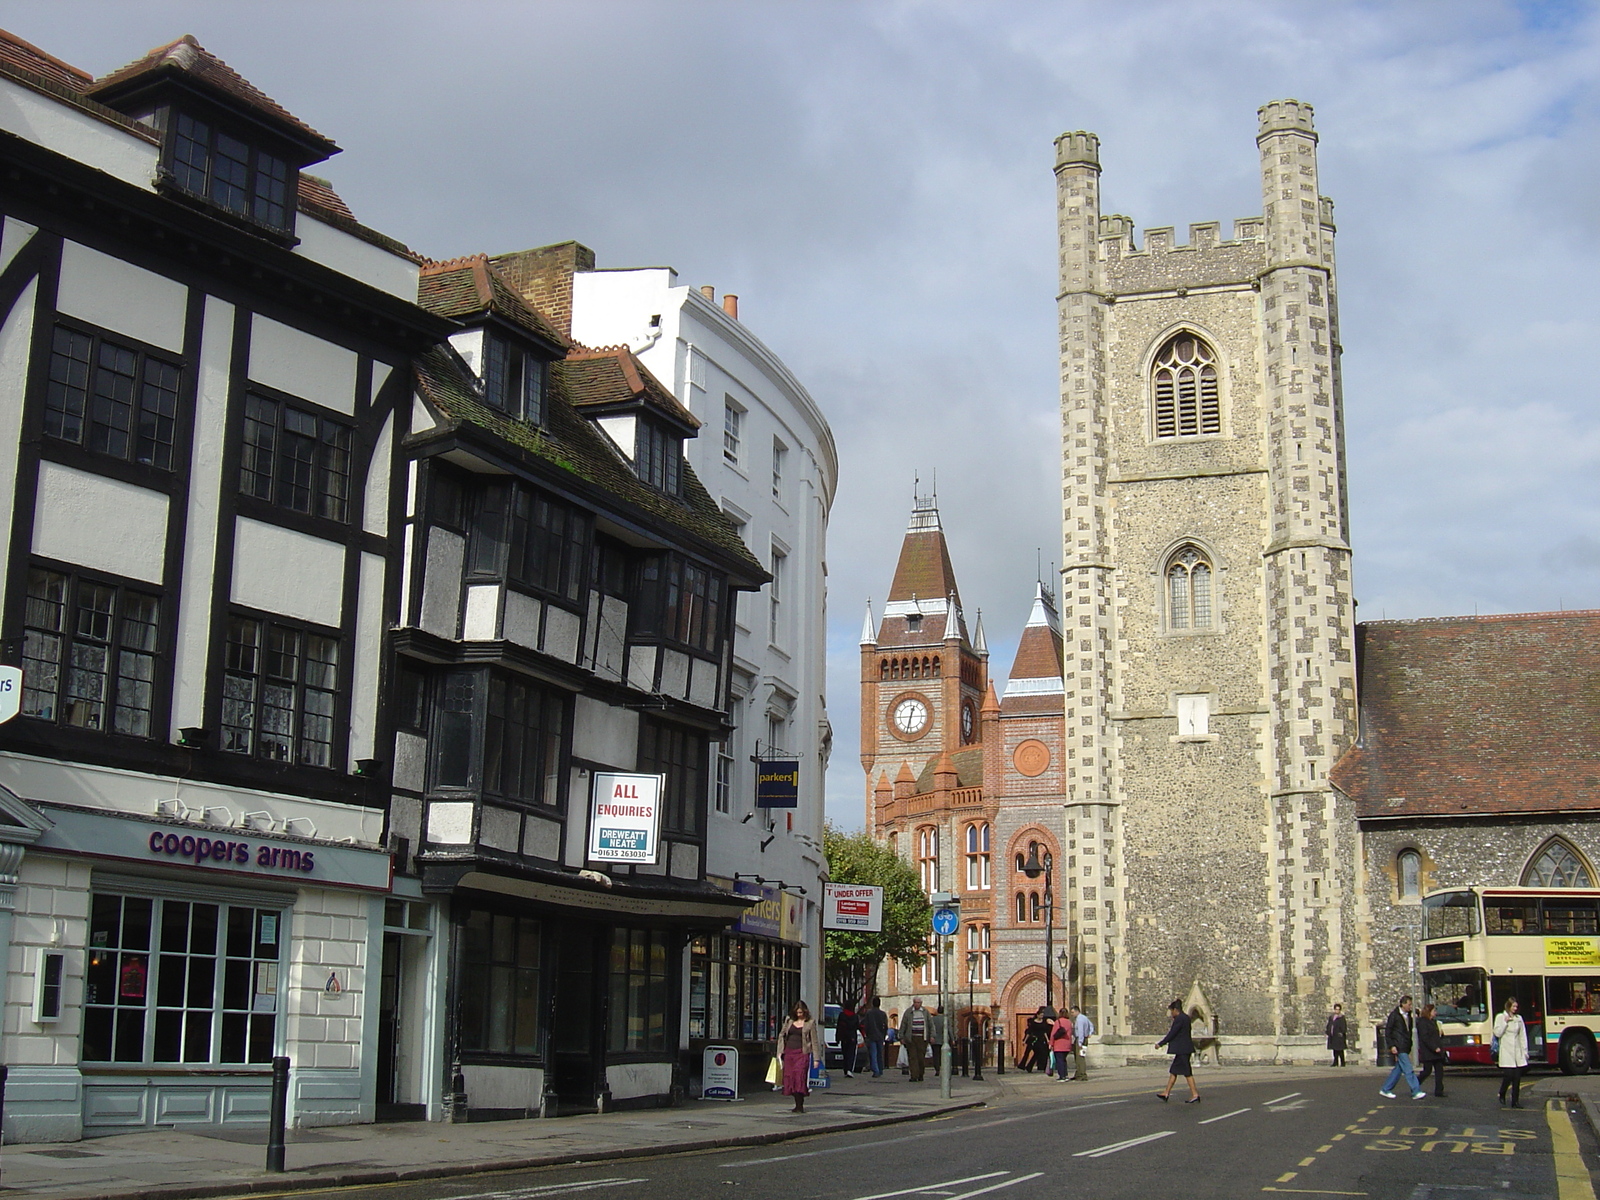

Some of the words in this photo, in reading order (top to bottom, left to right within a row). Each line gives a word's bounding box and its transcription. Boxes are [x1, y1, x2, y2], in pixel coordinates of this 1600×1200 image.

[759, 772, 793, 784] parkers
[613, 784, 639, 799] ALL
[597, 804, 653, 818] ENQUIRIES
[601, 829, 646, 841] DREWEATT
[609, 838, 637, 849] NEATE
[148, 831, 250, 864] coopers
[256, 845, 315, 872] arms
[597, 849, 619, 857] 01635
[620, 850, 647, 858] 263030
[833, 889, 854, 898] UNDER
[854, 889, 874, 898] OFFER
[1350, 1125, 1538, 1141] STOP
[1364, 1139, 1517, 1155] BUS
